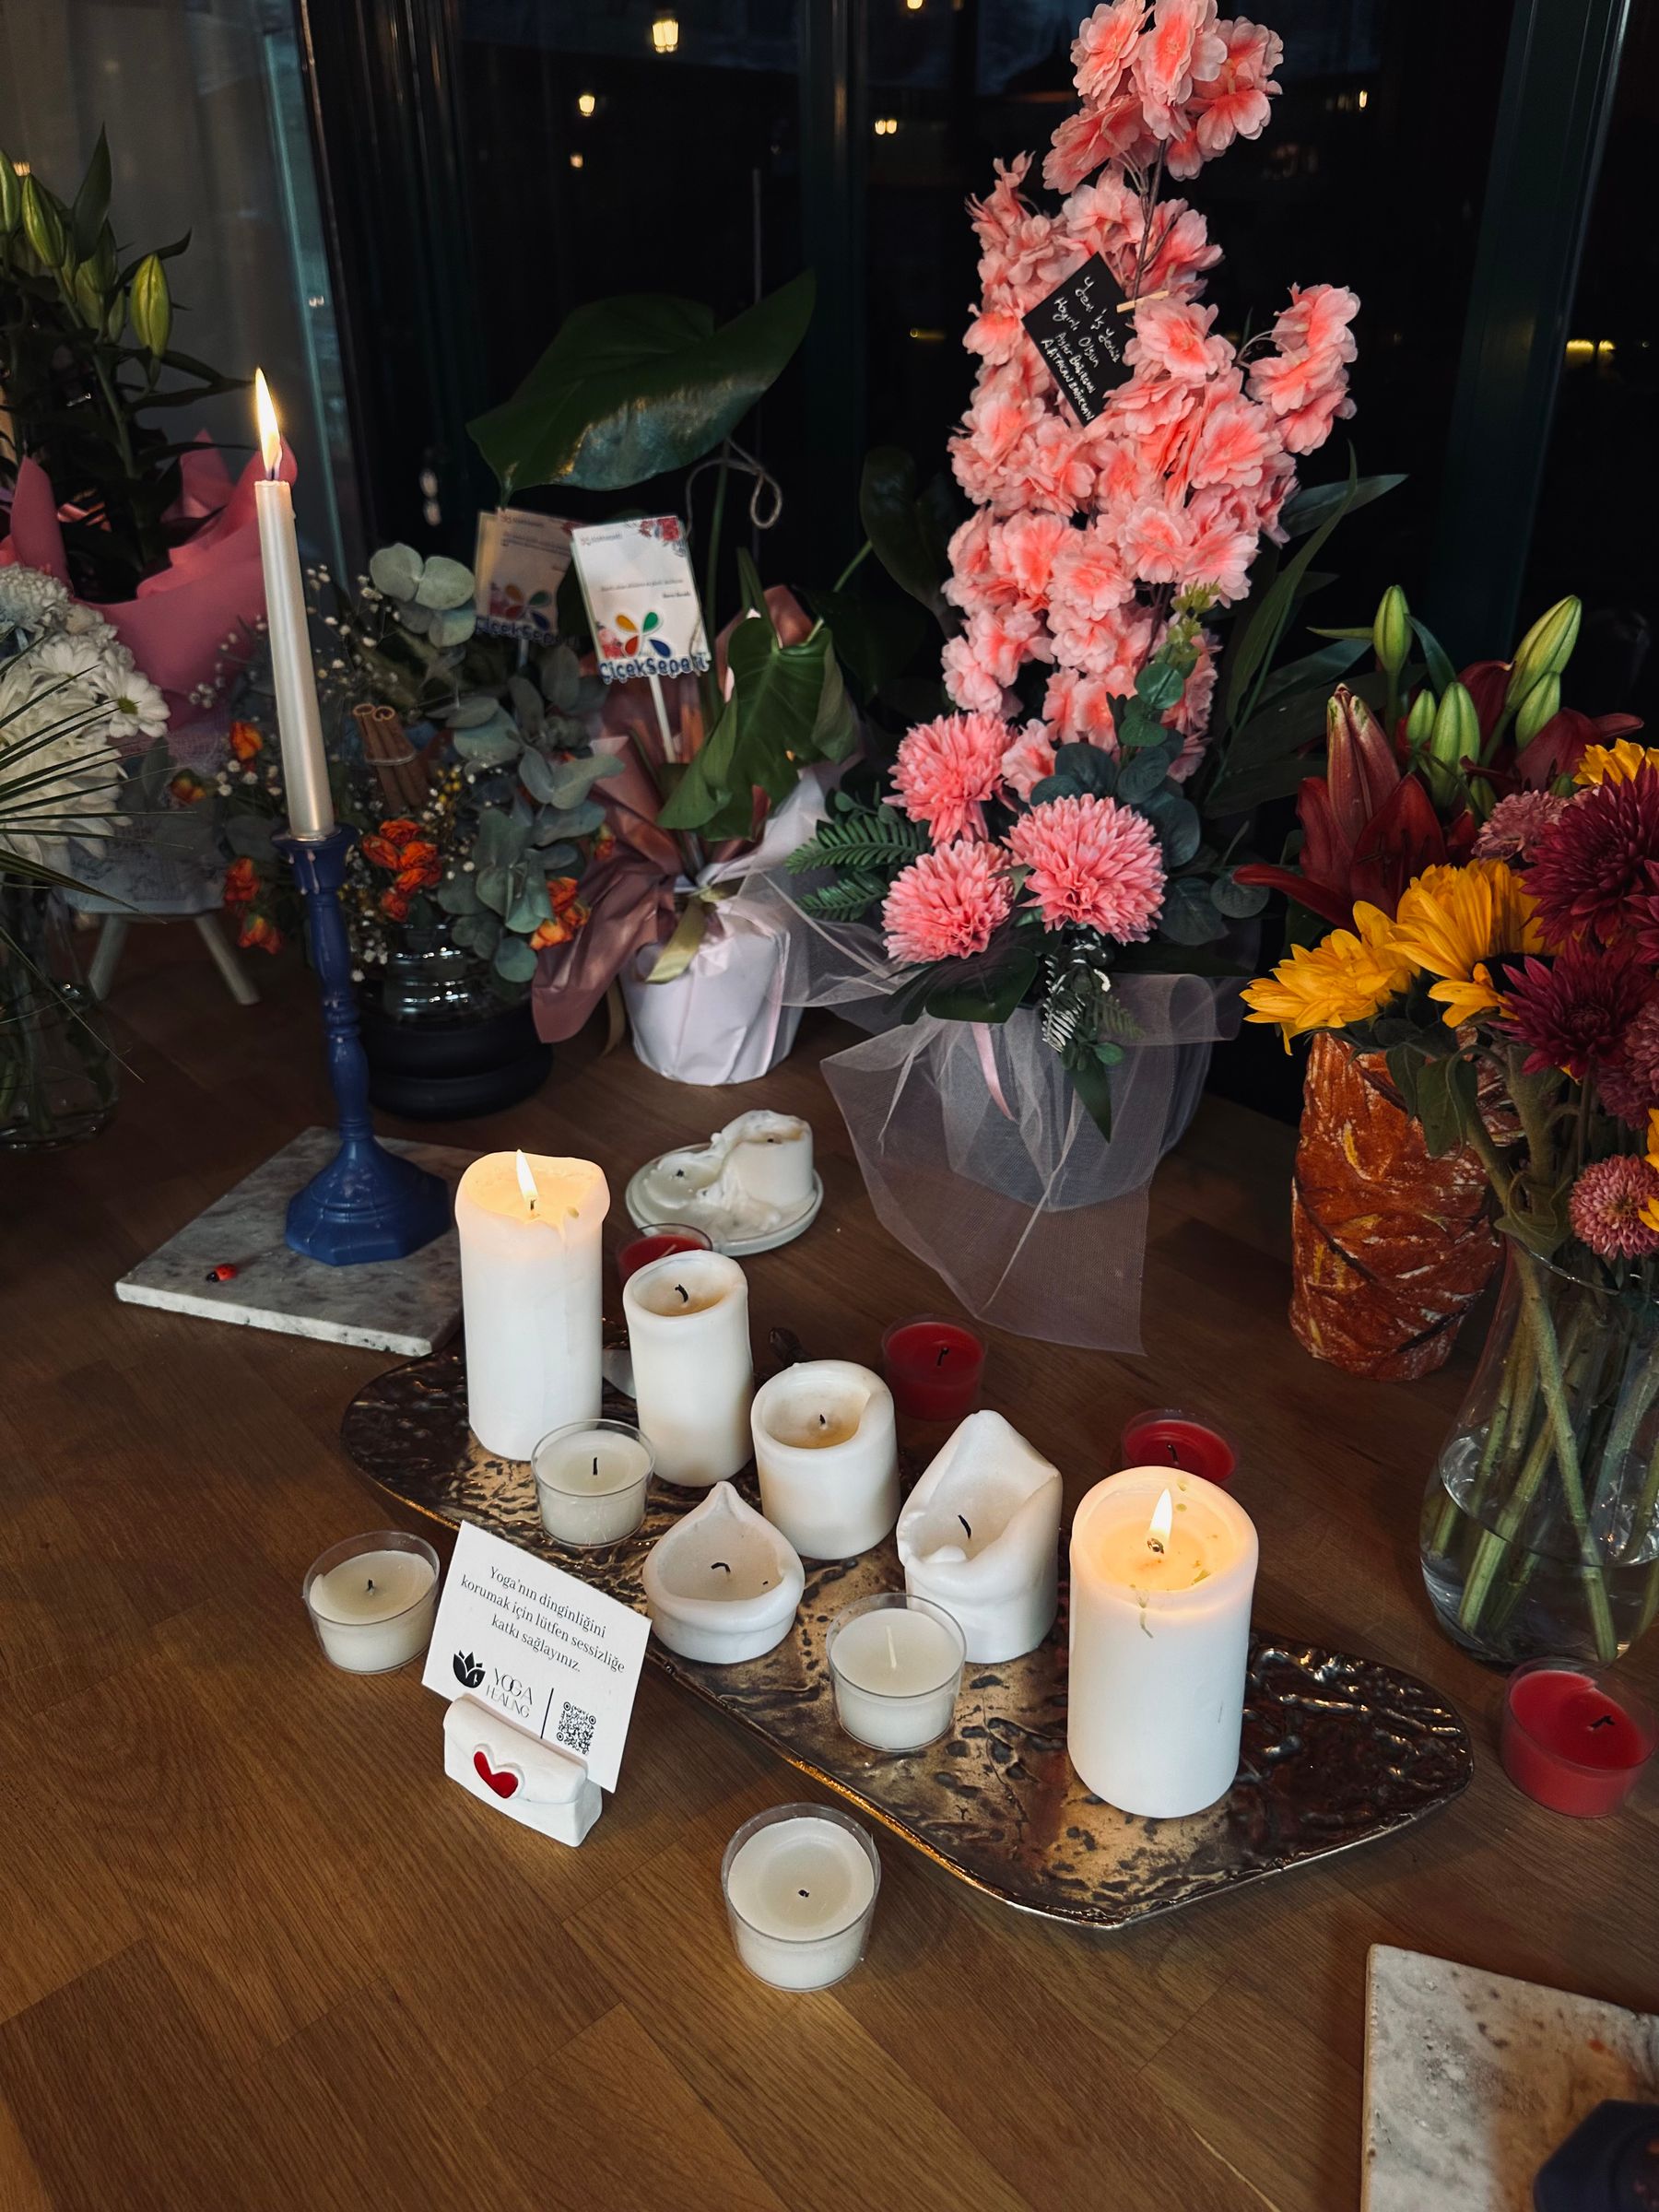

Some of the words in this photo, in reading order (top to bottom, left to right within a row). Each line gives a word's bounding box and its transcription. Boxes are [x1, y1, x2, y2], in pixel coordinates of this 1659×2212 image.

[1076, 276, 1094, 312] Yeni
[1078, 336, 1100, 368] Olsun
[461, 1574, 512, 1611] korumak
[512, 1602, 535, 1624] için
[536, 1613, 570, 1641] lütfen
[571, 1637, 626, 1673] sessizliğe
[488, 1566, 537, 1601] Yoga'nın
[539, 1593, 607, 1639] dinginliğini
[491, 1614, 520, 1640] katkı
[521, 1630, 582, 1673] sağlayınız.
[494, 1667, 534, 1705] YOGA
